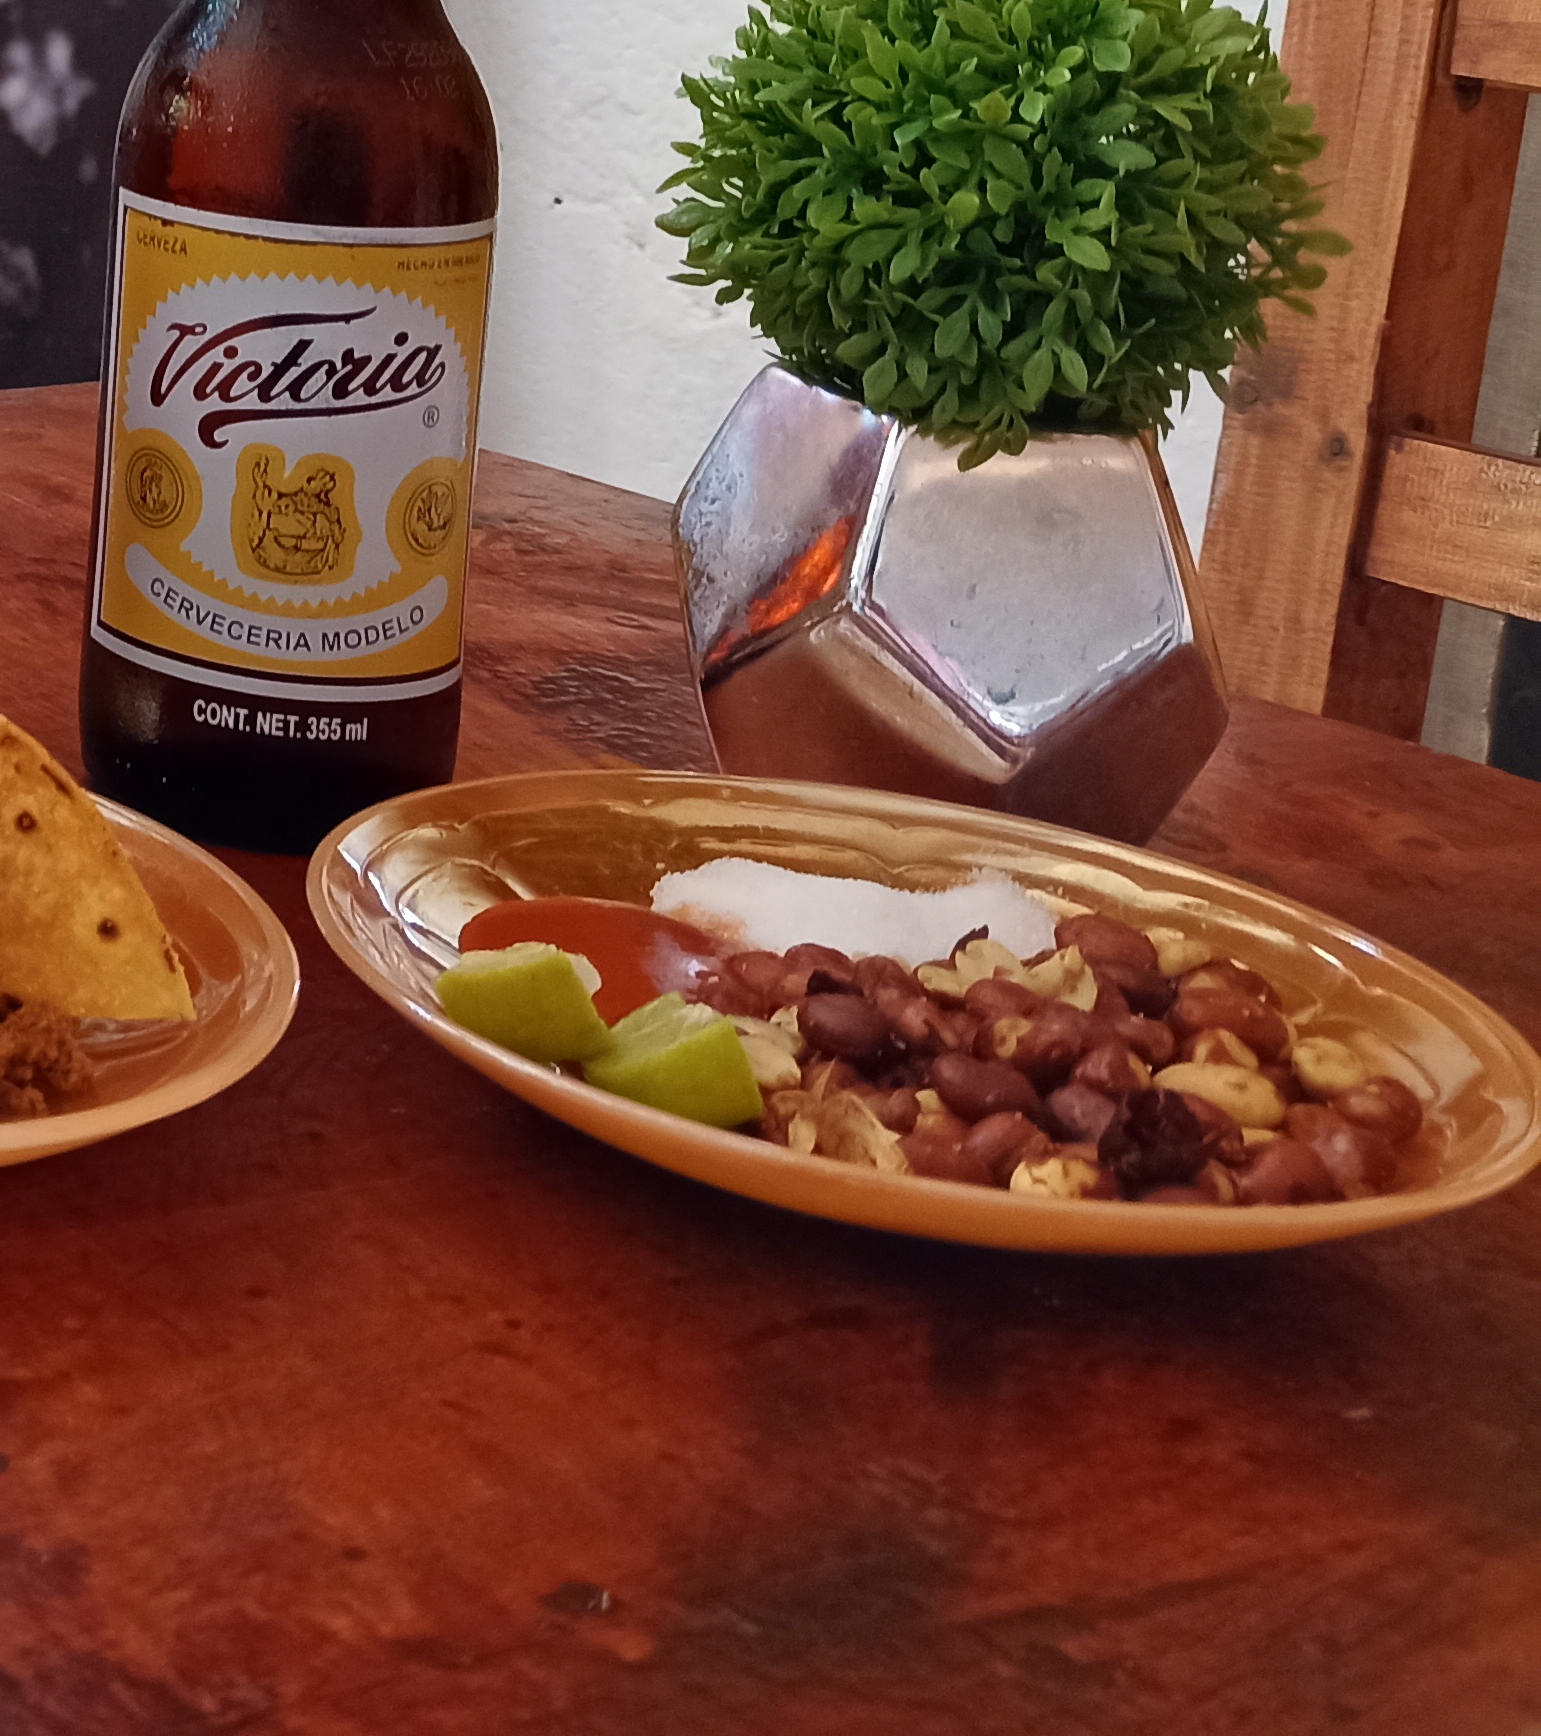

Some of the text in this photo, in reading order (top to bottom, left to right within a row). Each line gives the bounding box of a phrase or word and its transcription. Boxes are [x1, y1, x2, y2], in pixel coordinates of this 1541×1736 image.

[149, 305, 446, 450] Victoria
[150, 577, 424, 652] CERVECERIA MODELO
[193, 699, 368, 742] CONT. NET. 355 ml
